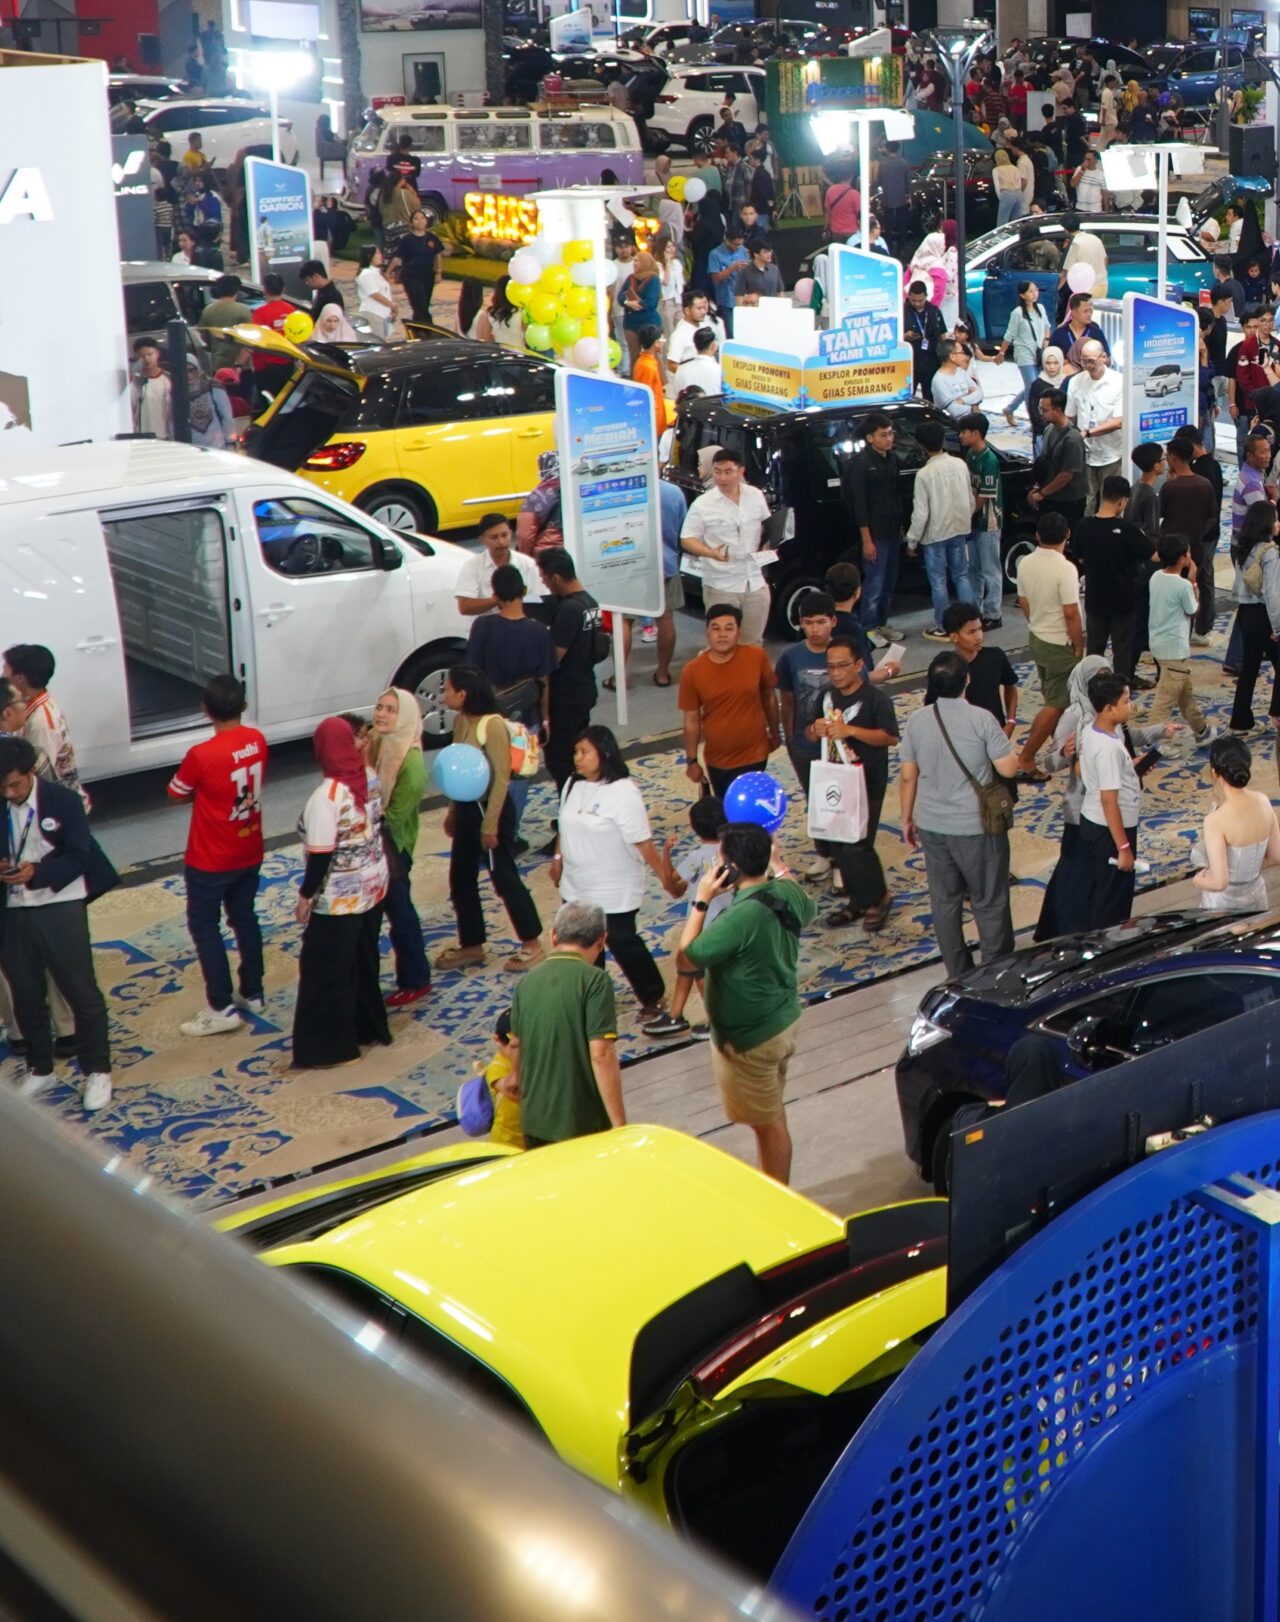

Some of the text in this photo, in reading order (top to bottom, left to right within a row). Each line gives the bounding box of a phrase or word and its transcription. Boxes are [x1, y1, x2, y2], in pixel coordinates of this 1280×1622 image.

[259, 202, 304, 213] DARION
[845, 315, 871, 329] YUK
[822, 322, 894, 353] TANYA
[829, 345, 887, 363] KAMI YA!
[732, 360, 791, 379] EKSPLOR PROMONYA
[819, 365, 896, 381] EKSPLOR PROMONYA
[735, 378, 789, 398] GIIAS SEMARANG
[823, 381, 893, 399] GIIAS SEMARANG
[583, 427, 637, 447] MERIAH
[232, 741, 259, 764] yudhi
[230, 760, 262, 821] 11
